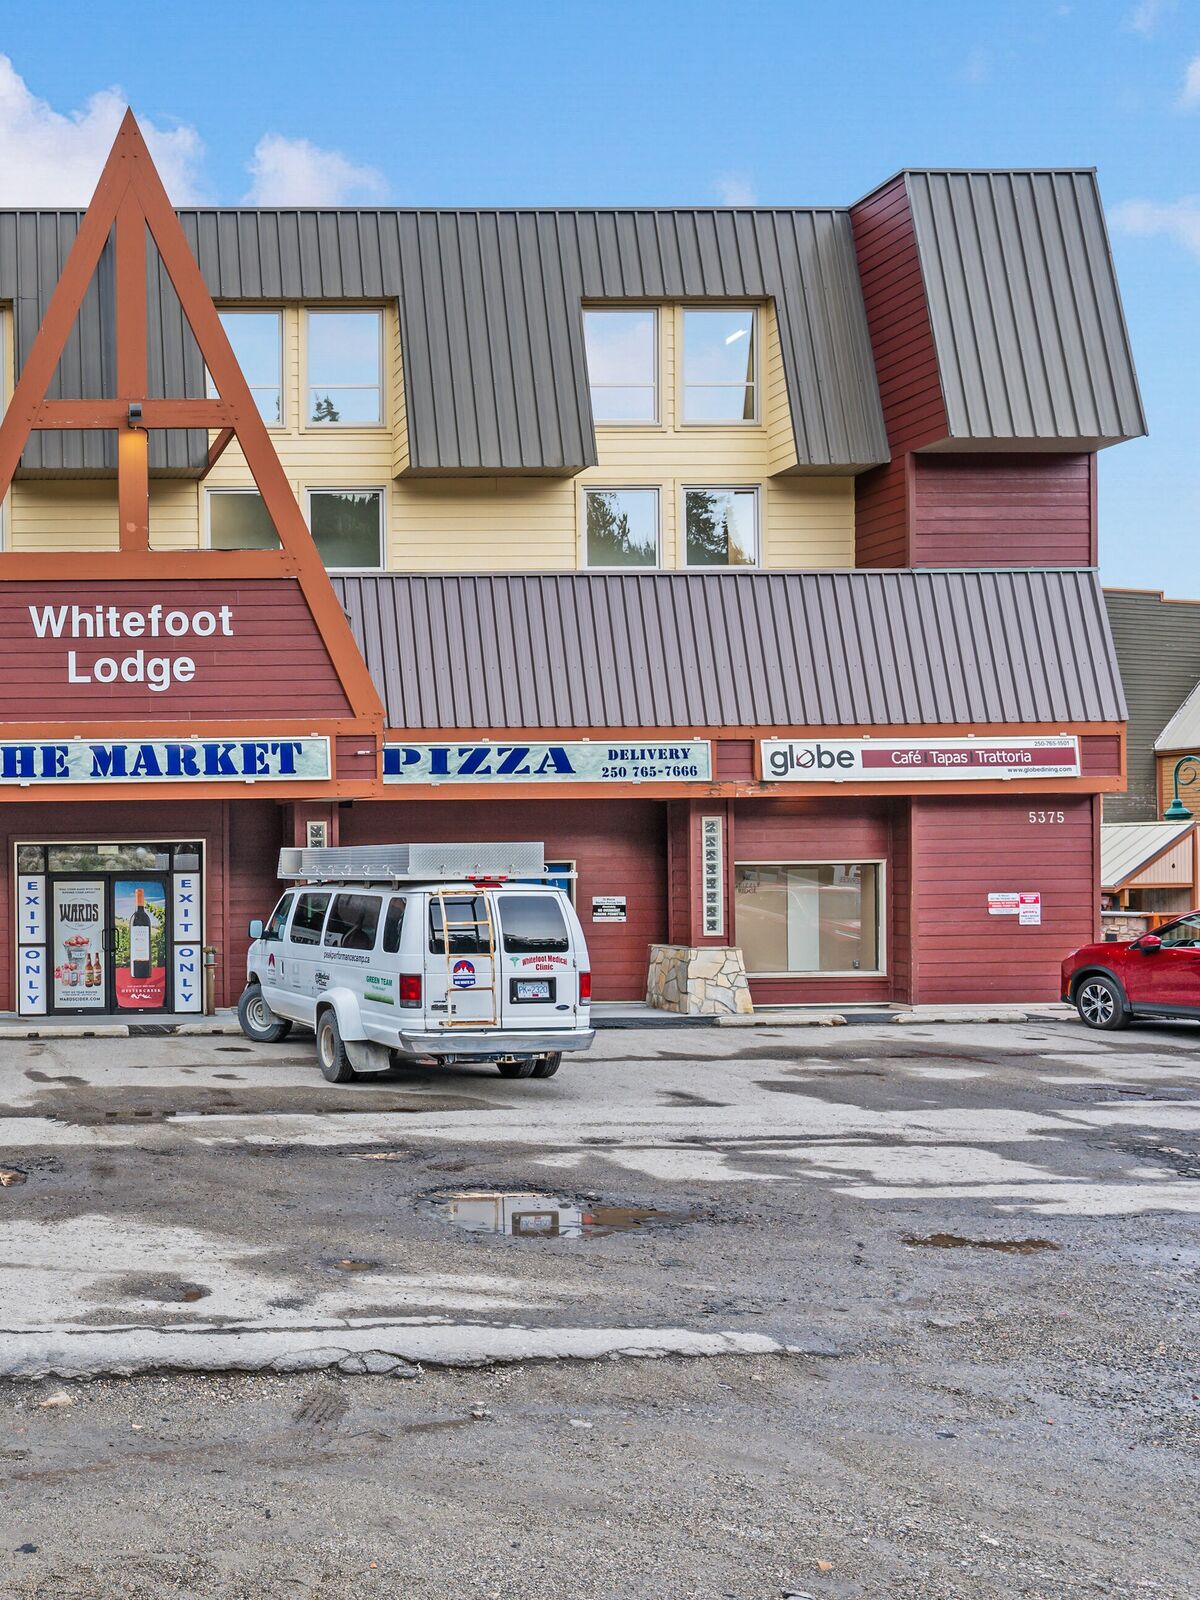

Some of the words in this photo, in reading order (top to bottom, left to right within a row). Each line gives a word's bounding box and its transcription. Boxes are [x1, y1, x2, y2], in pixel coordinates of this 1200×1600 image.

[28, 604, 234, 638] Whitefoot
[67, 649, 196, 692] Lodge
[89, 742, 303, 777] MARKET
[383, 747, 576, 775] PIZZA
[607, 748, 691, 761] DELIVERY
[769, 744, 855, 777] globe
[891, 750, 921, 764] Café
[932, 750, 968, 767] Tapas
[975, 750, 1032, 763] Trattoria
[601, 766, 627, 778] 250
[632, 765, 698, 777] 765-7666
[1007, 766, 1073, 774] www.globedining.com
[1029, 811, 1065, 824] 5375
[25, 881, 40, 935] EXIT
[59, 903, 99, 922] WARDS
[179, 879, 193, 932] EXIT
[522, 955, 547, 966] Whitefoot
[547, 954, 568, 966] Medical
[535, 963, 554, 971] Clinic
[25, 950, 41, 1004] ONLY
[179, 948, 194, 1002] ONLY
[366, 975, 380, 984] GREEN
[380, 977, 393, 986] TEAM
